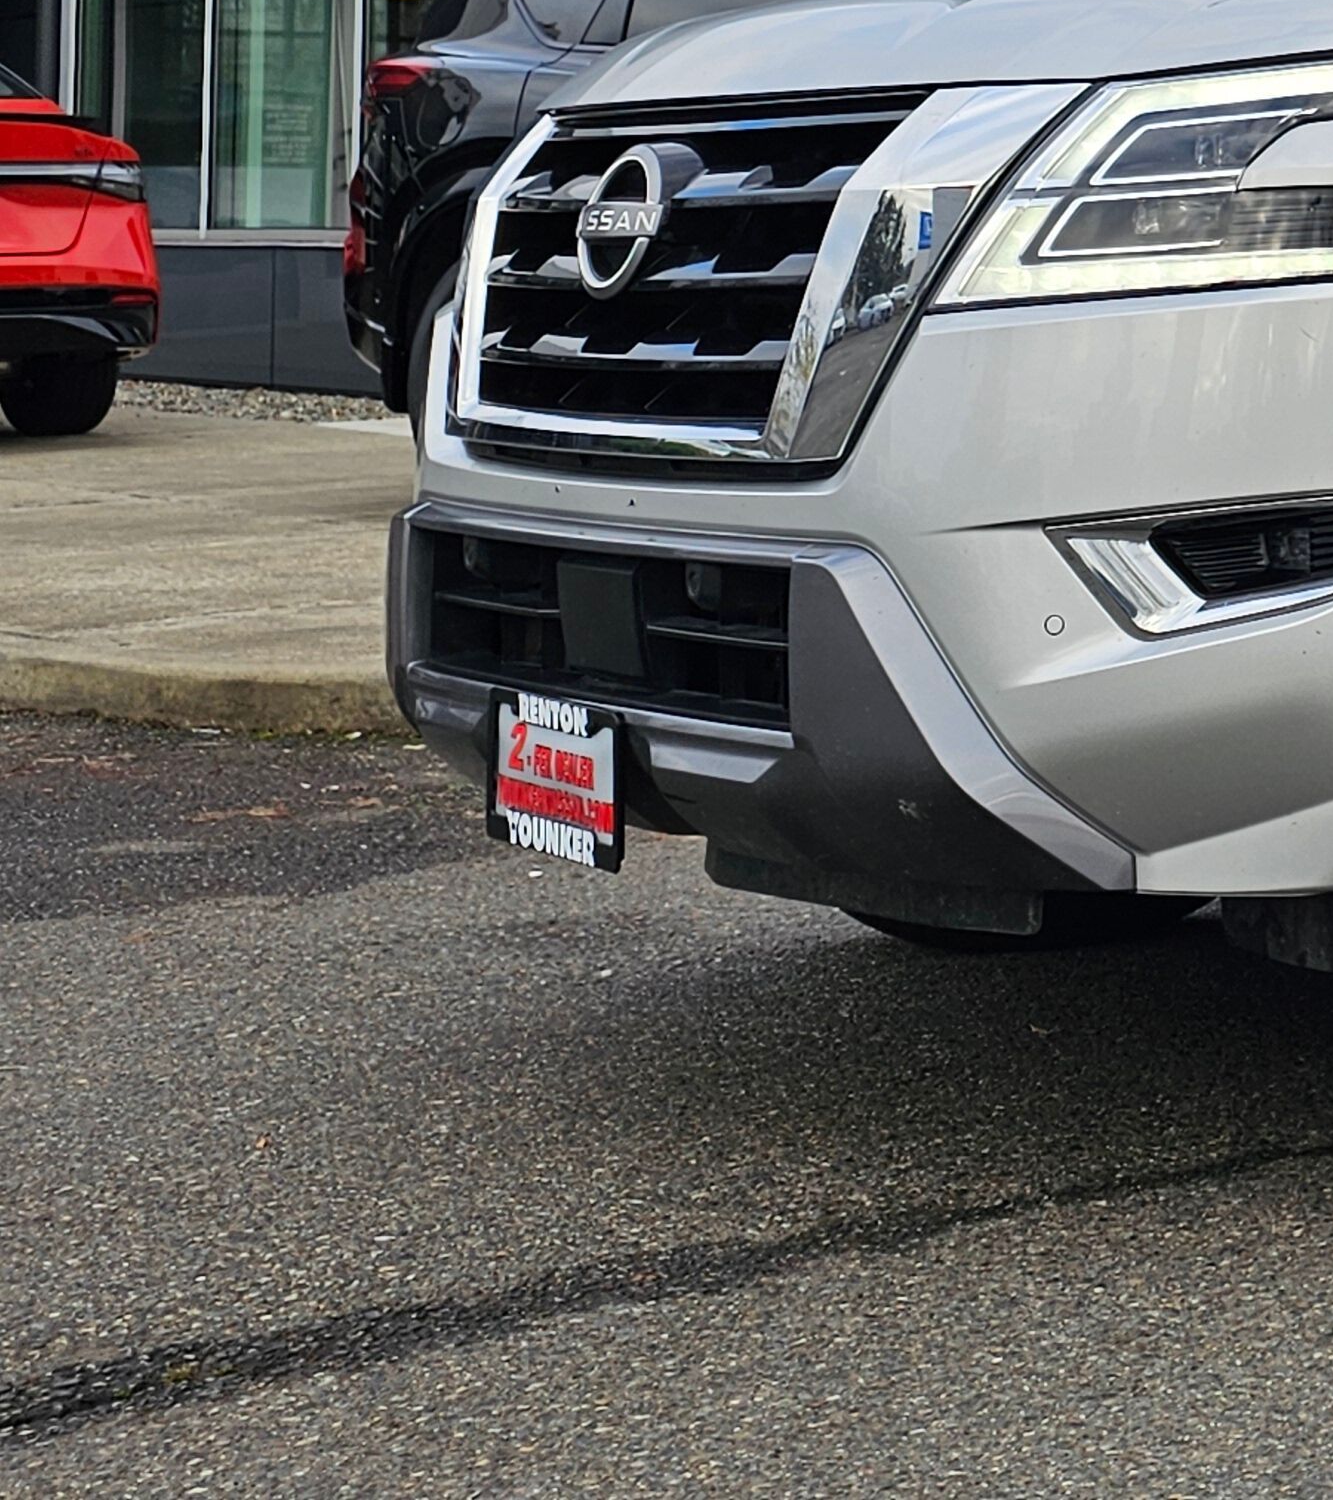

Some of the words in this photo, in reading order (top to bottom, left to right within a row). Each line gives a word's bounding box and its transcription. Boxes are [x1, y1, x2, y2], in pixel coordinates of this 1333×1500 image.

[585, 209, 657, 232] SSAN
[518, 692, 588, 738] RENTON
[506, 808, 596, 868] YOUNKER
